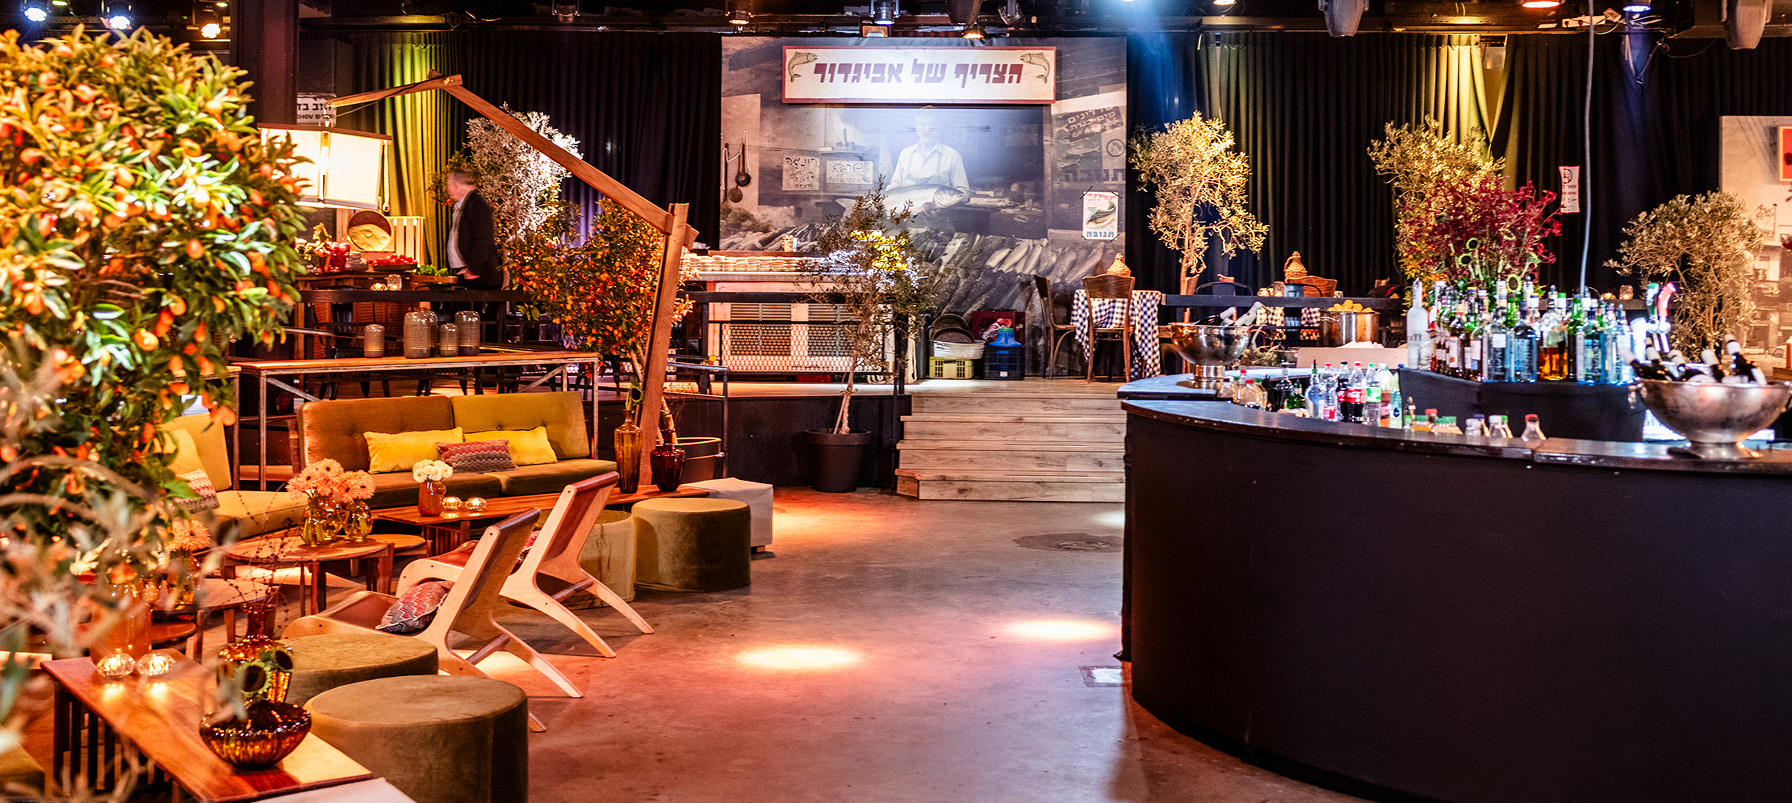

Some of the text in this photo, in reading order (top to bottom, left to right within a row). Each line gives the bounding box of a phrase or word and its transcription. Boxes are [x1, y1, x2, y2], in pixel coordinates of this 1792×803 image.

[813, 58, 1024, 88] הצריף של אביגדור
[1064, 168, 1125, 182] תנובה
